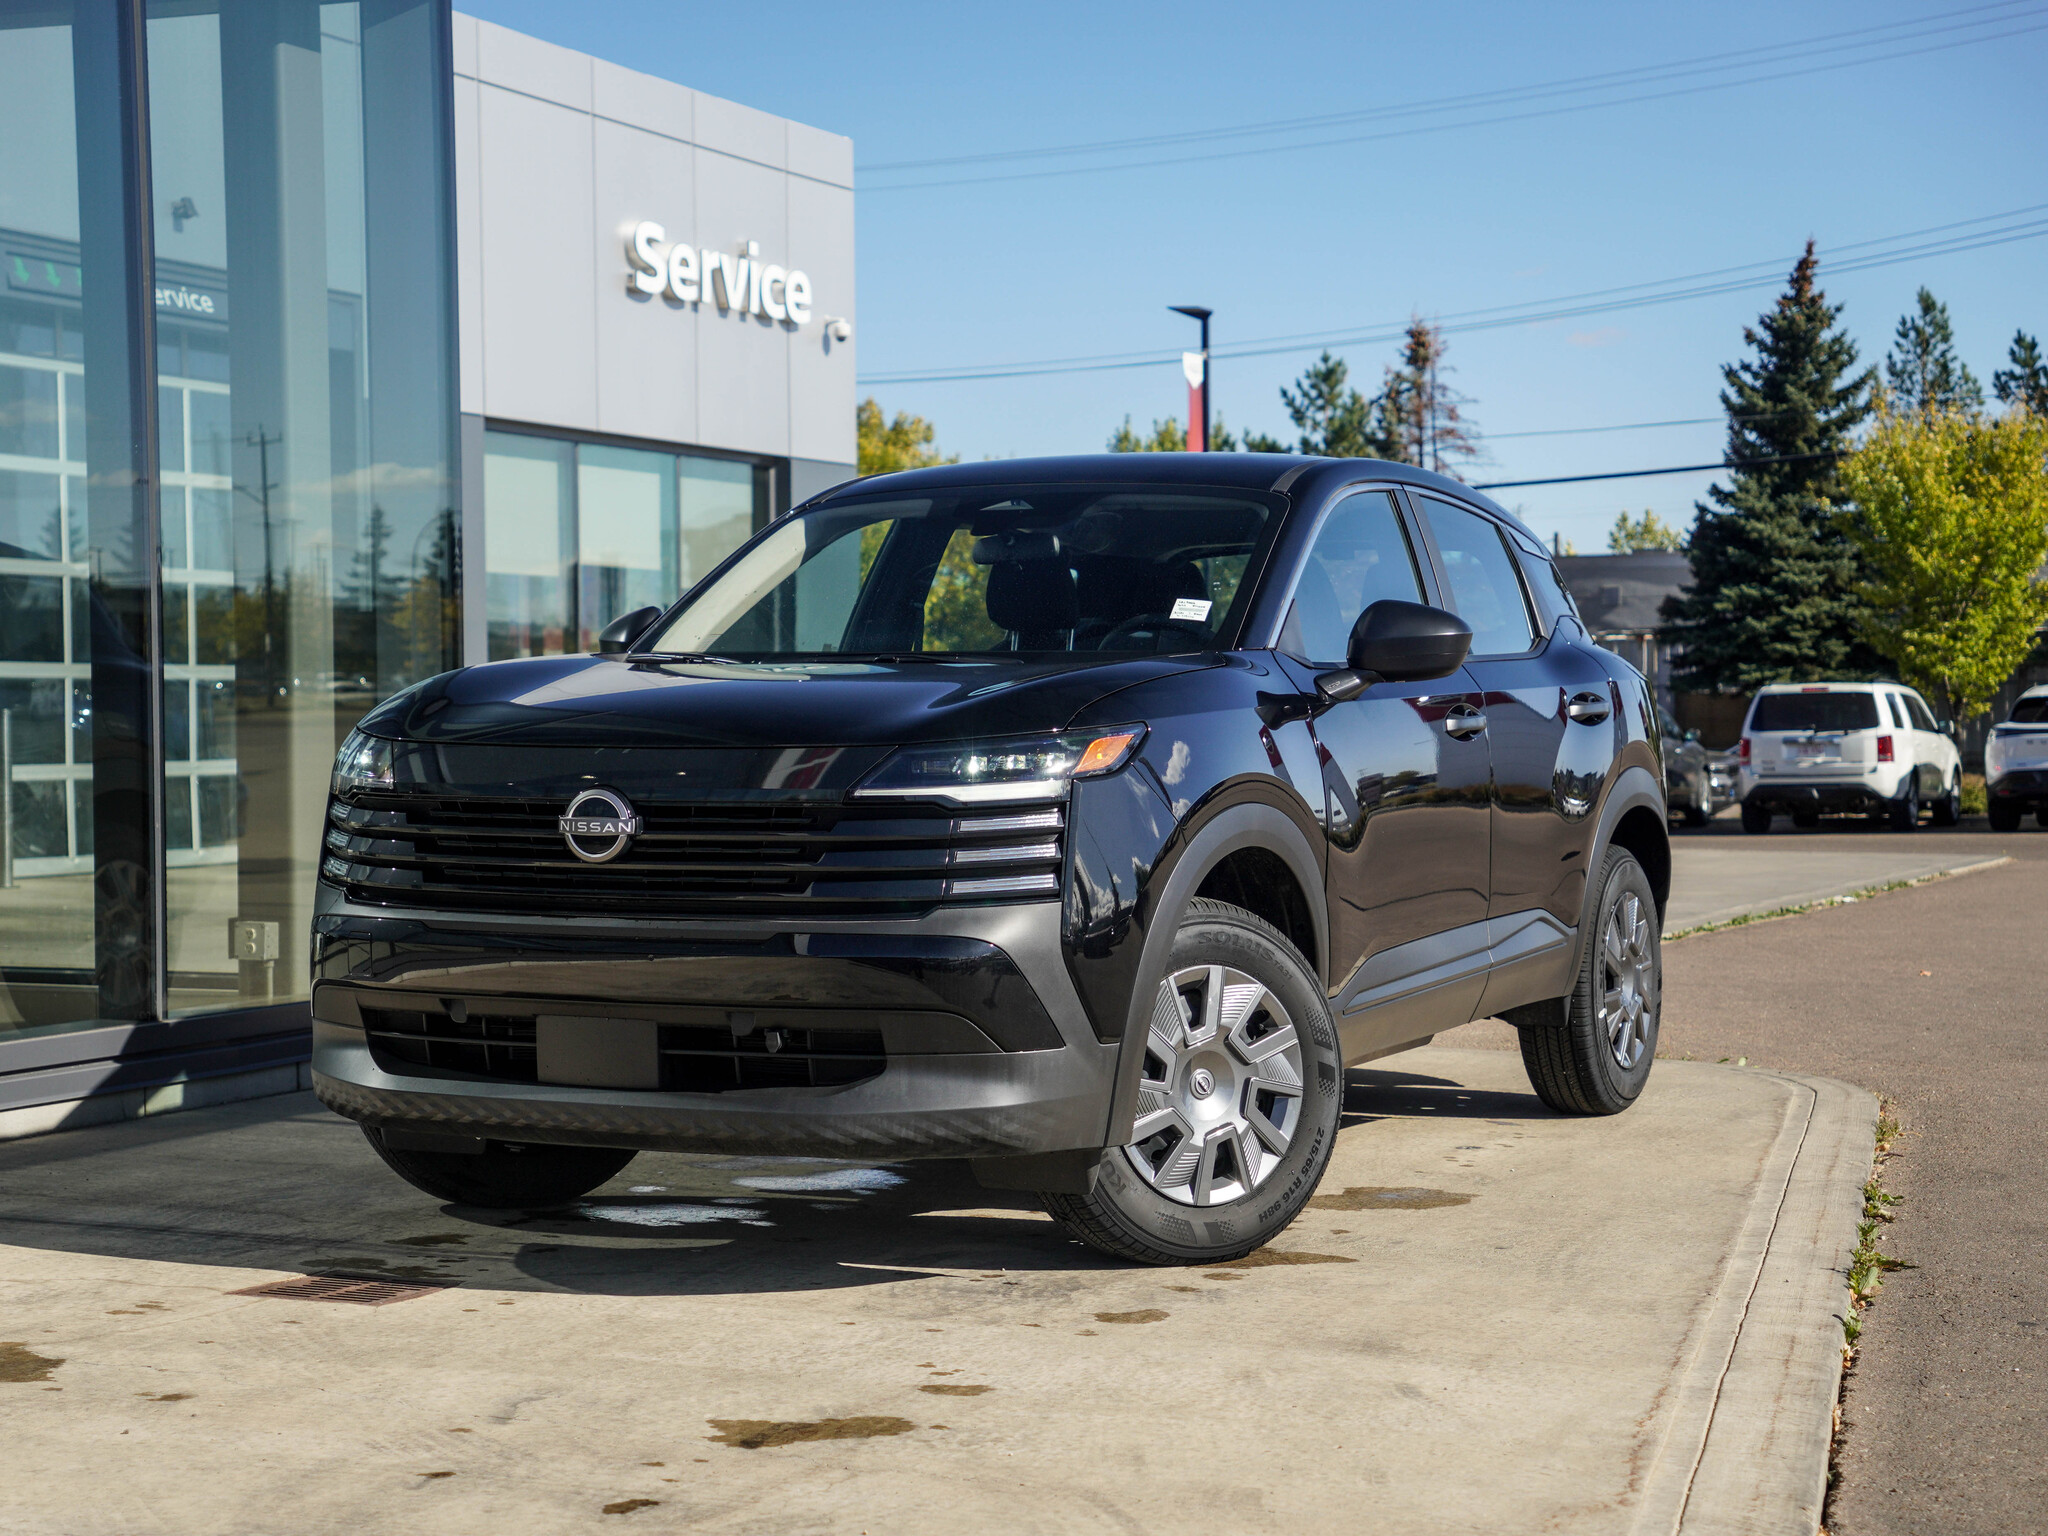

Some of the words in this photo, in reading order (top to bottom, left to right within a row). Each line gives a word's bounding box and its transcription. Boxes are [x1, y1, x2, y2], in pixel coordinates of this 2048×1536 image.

[634, 220, 813, 325] Service
[559, 820, 632, 833] NISSAN
[1301, 1126, 1325, 1178] 215/65
[1282, 1176, 1303, 1202] R16
[1258, 1200, 1282, 1223] 98H
